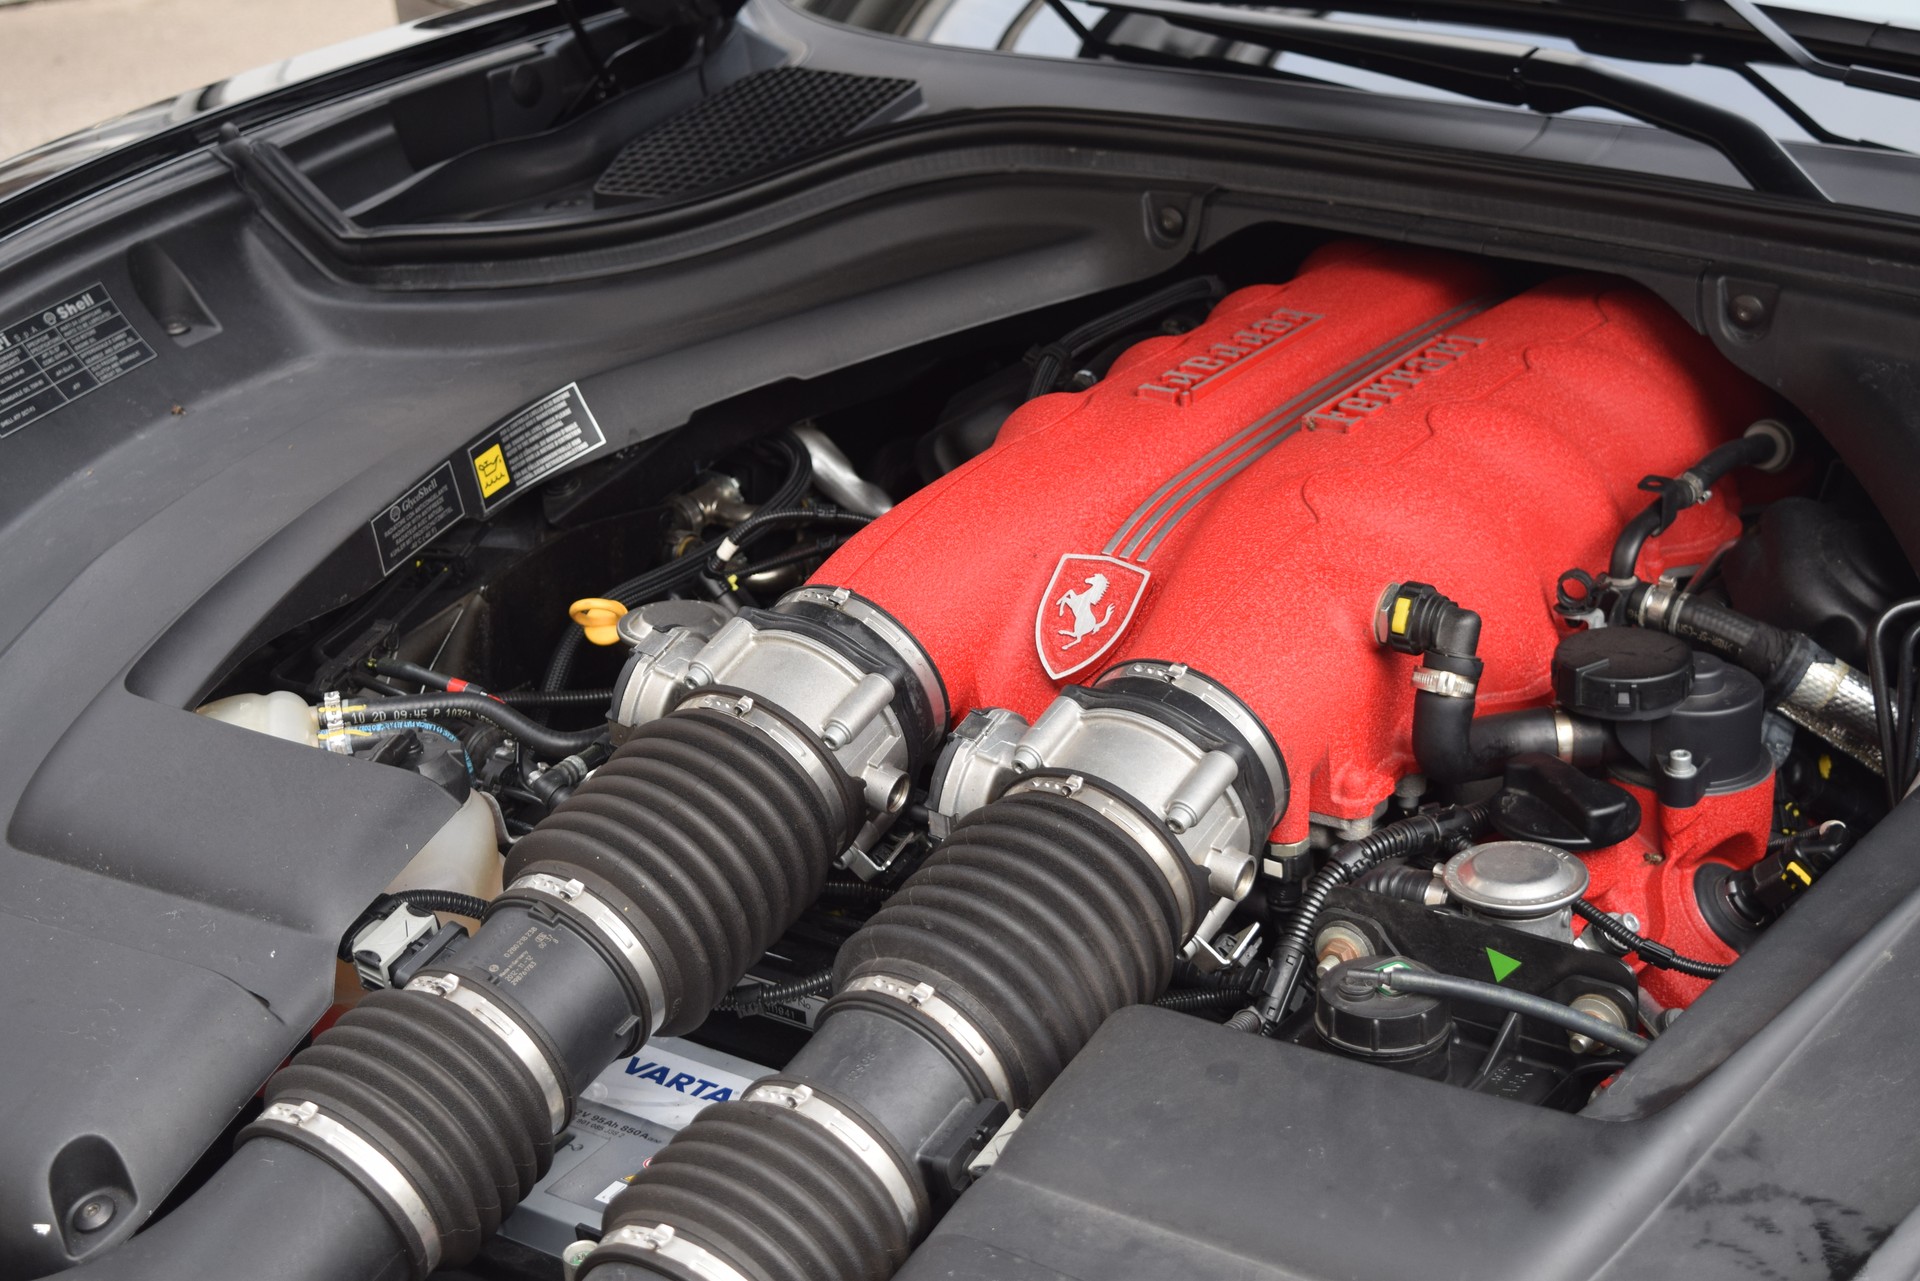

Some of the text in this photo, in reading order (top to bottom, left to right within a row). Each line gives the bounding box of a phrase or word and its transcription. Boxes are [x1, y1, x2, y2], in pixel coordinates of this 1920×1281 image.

[56, 293, 95, 319] Shell
[1137, 308, 1325, 406] Ferrari
[1303, 334, 1488, 433] Ferrari
[401, 478, 438, 512] GlycoShell
[624, 1056, 734, 1103] VARTA
[590, 1113, 619, 1129] 95Ah
